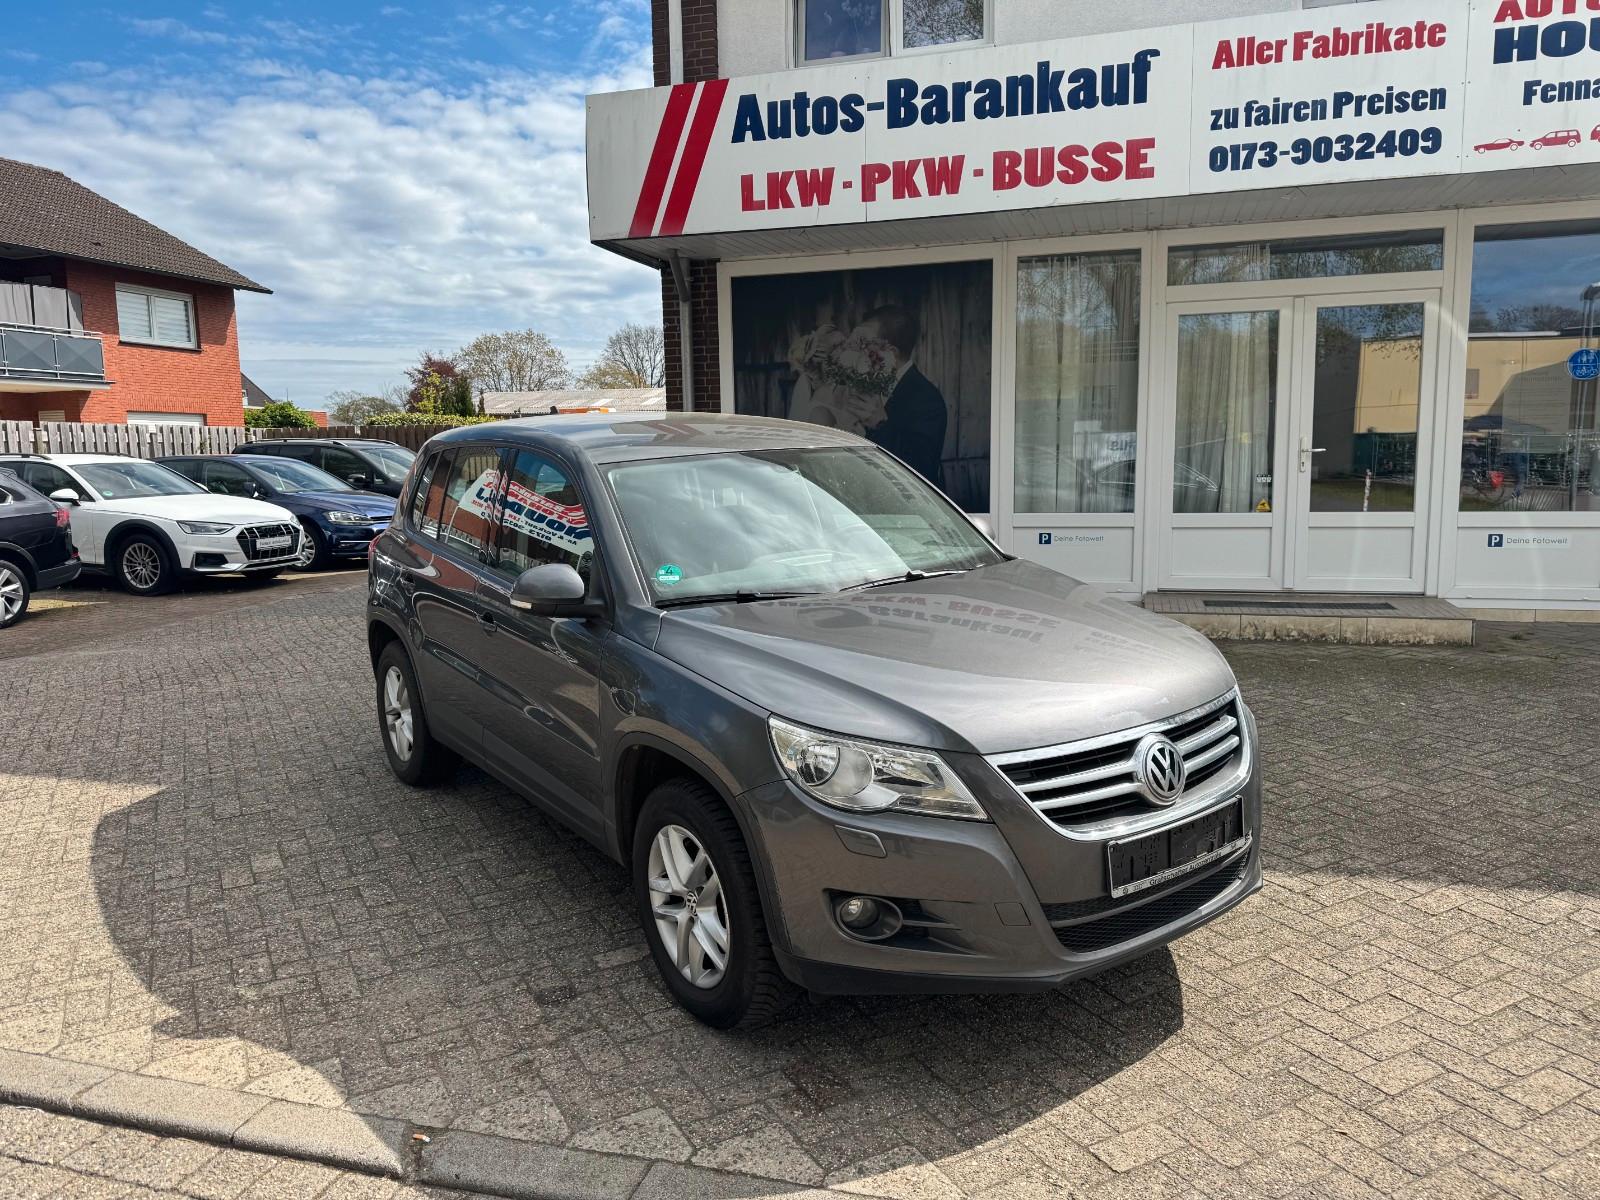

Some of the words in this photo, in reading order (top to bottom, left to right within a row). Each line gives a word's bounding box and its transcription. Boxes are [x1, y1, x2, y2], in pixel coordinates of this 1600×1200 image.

[1212, 38, 1287, 69] Aller
[1293, 22, 1446, 61] Fabrikate
[731, 48, 1160, 144] Autos-Barankauf
[1210, 107, 1239, 131] zu
[1244, 97, 1328, 128] fairen
[1333, 86, 1447, 119] Preisen
[1208, 126, 1443, 173] 0173-9032409
[741, 167, 835, 211] LKW
[861, 155, 966, 202] PKW
[992, 138, 1156, 191] BUSSE
[1054, 535, 1074, 543] Deine
[1506, 537, 1530, 545] Deine
[1144, 741, 1184, 800] VW
